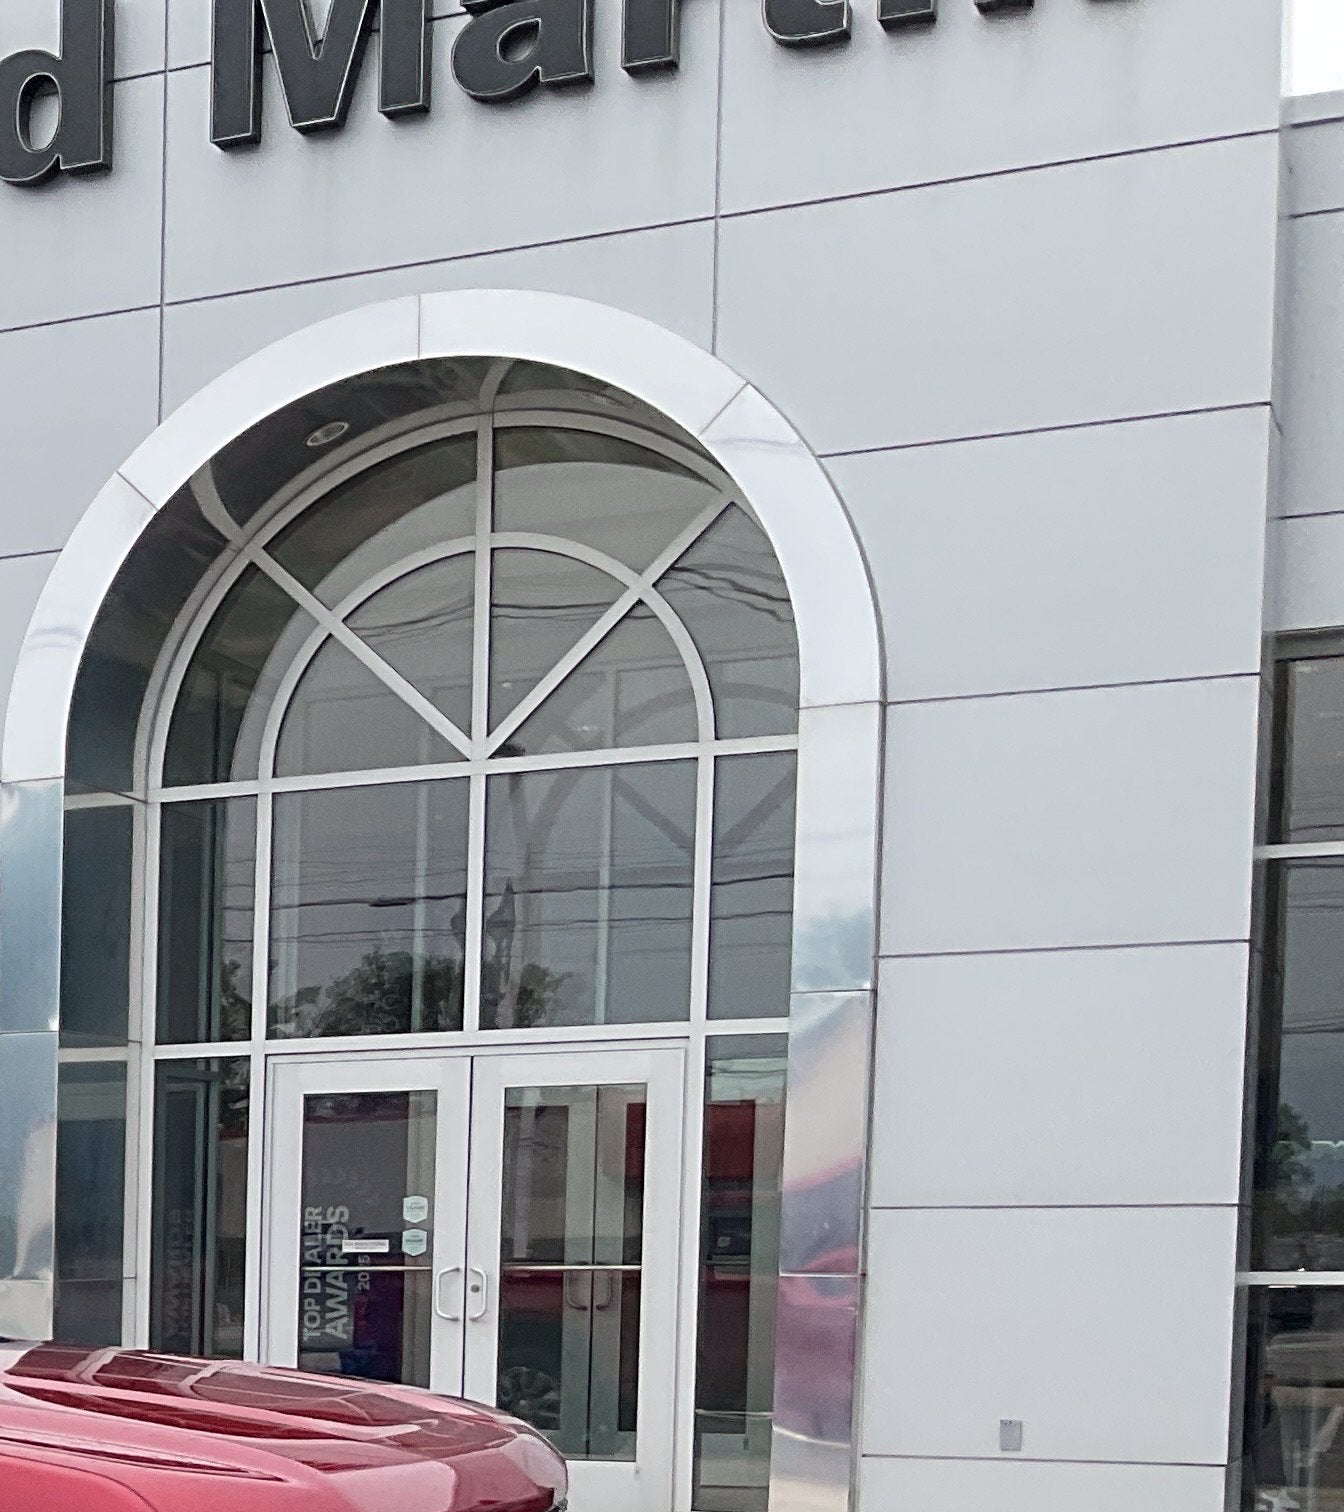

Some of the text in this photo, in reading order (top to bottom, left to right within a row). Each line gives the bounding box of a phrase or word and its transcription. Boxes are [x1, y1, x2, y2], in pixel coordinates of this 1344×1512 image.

[325, 1204, 350, 1340] AWARDS
[357, 1254, 371, 1291] 205
[303, 1297, 322, 1341] TOP
